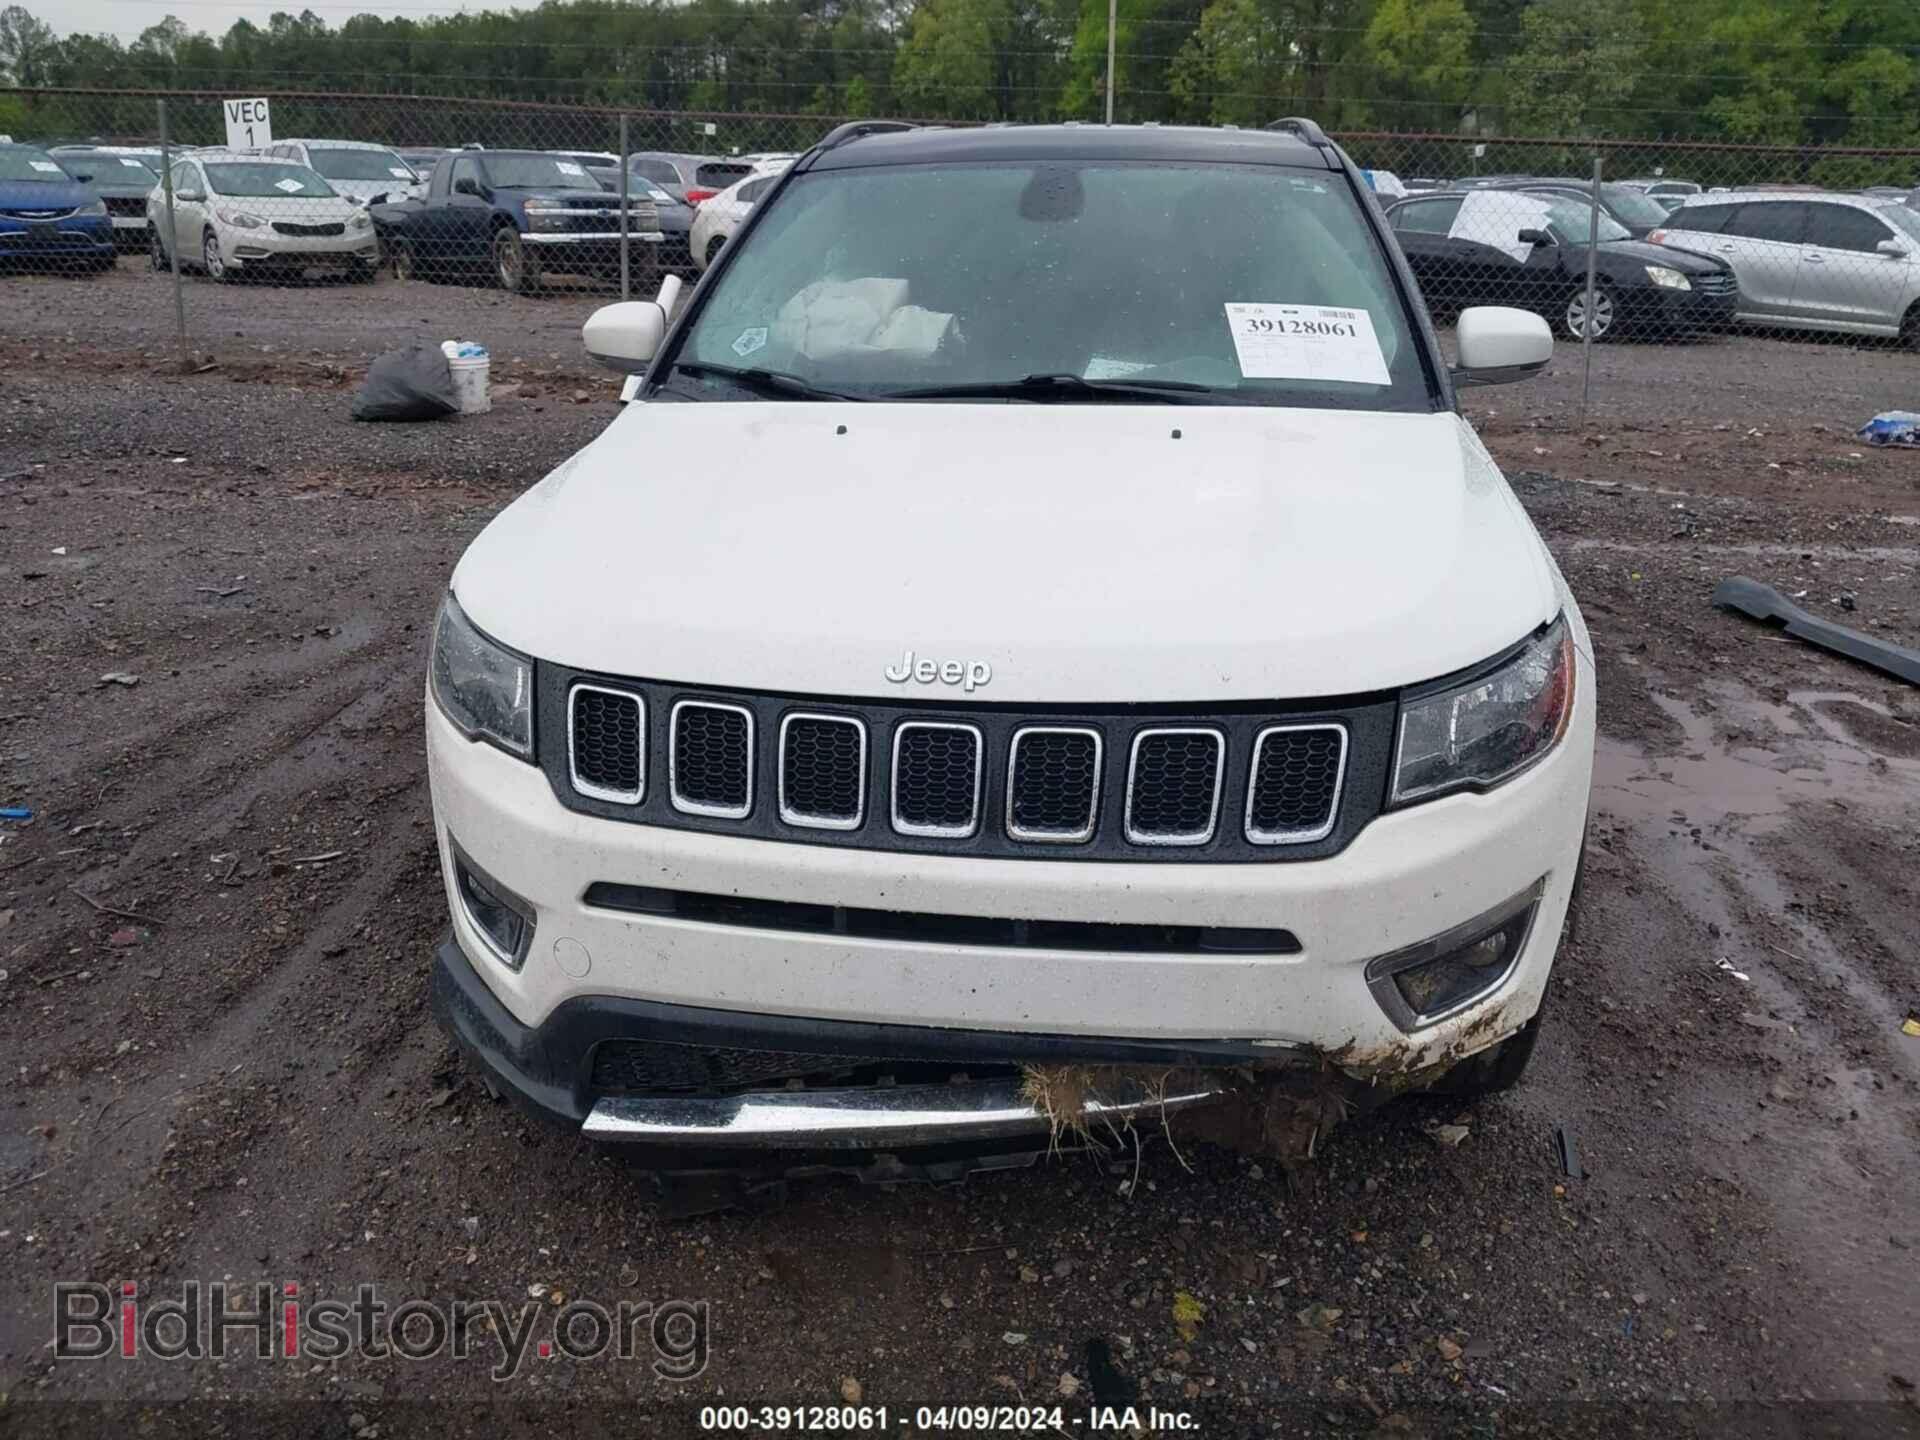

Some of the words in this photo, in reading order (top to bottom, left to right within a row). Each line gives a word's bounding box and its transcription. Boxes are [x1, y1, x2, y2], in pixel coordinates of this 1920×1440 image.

[227, 101, 266, 123] VEC
[245, 126, 254, 147] 1
[1246, 318, 1358, 337] 39128061
[884, 650, 993, 692] Jeep
